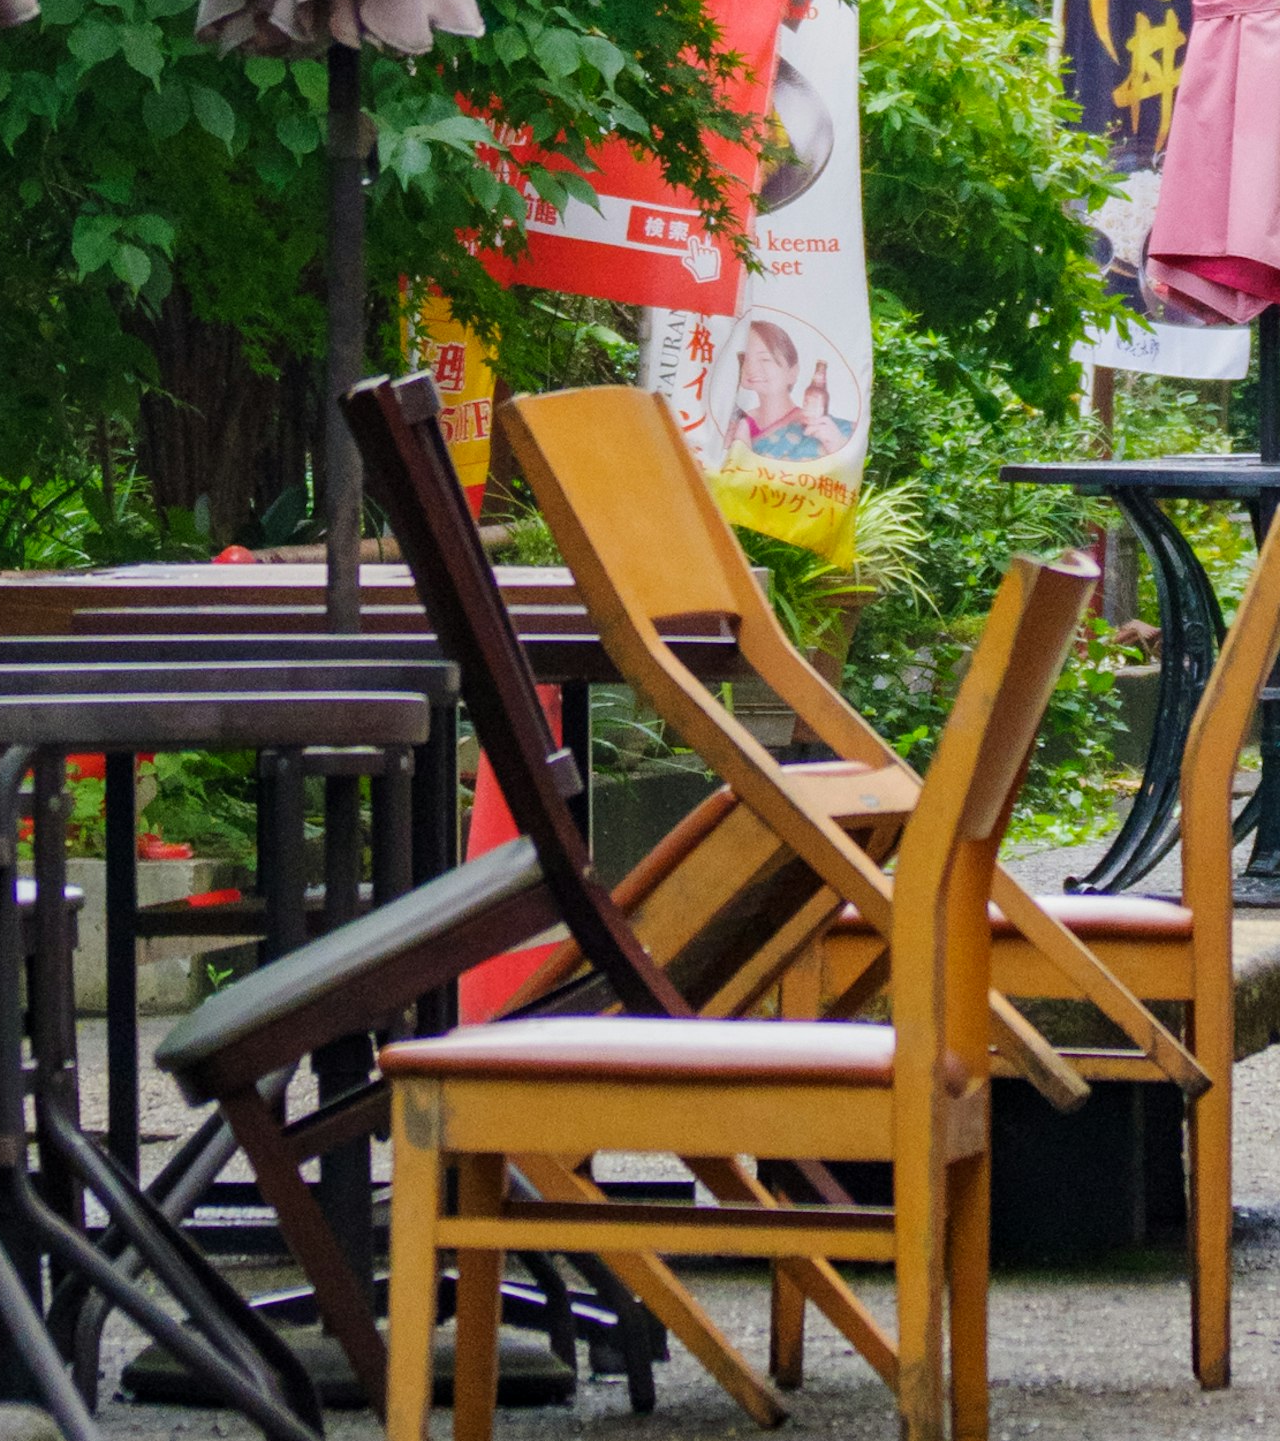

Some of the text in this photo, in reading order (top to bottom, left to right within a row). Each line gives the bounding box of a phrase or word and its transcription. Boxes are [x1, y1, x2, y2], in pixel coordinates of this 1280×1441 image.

[643, 215, 691, 243] 検索
[767, 230, 841, 253] keema
[770, 259, 803, 276] set
